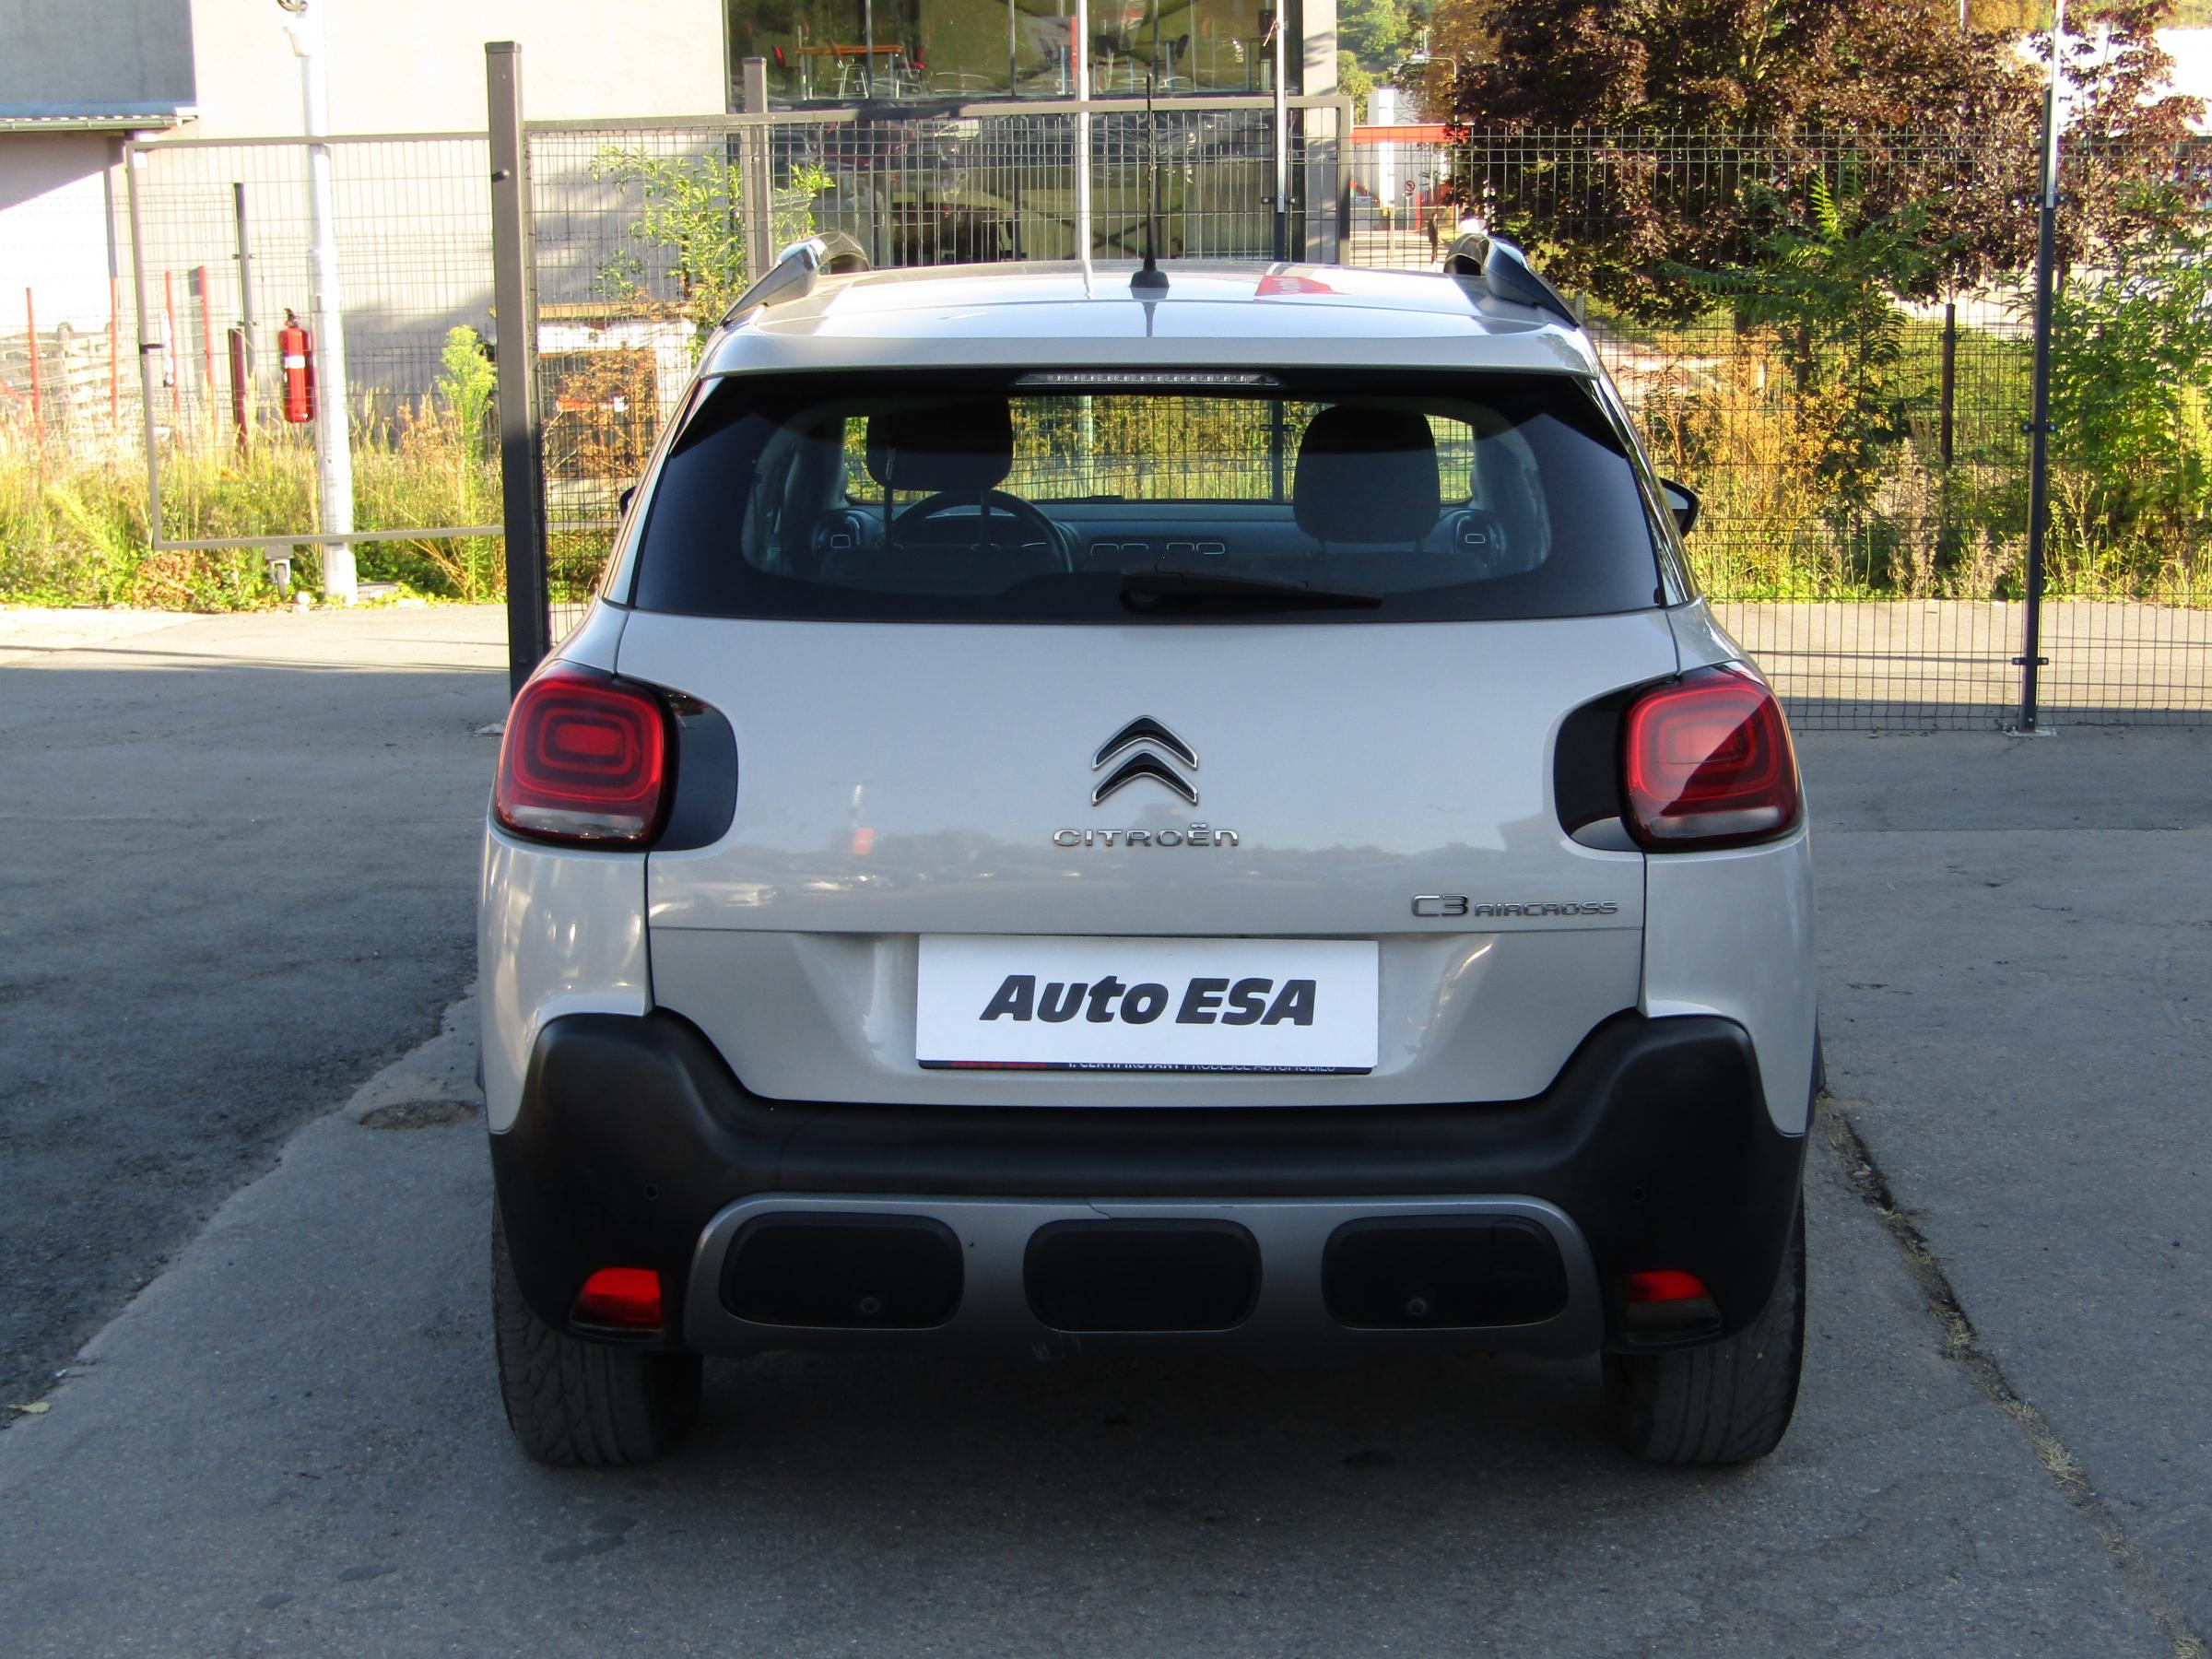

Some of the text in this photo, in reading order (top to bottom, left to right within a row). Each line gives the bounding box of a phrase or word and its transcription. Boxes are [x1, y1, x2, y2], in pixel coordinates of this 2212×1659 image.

[1411, 894, 1618, 917] C3 AIRCROSS
[979, 975, 1316, 1026] Auto ESA
